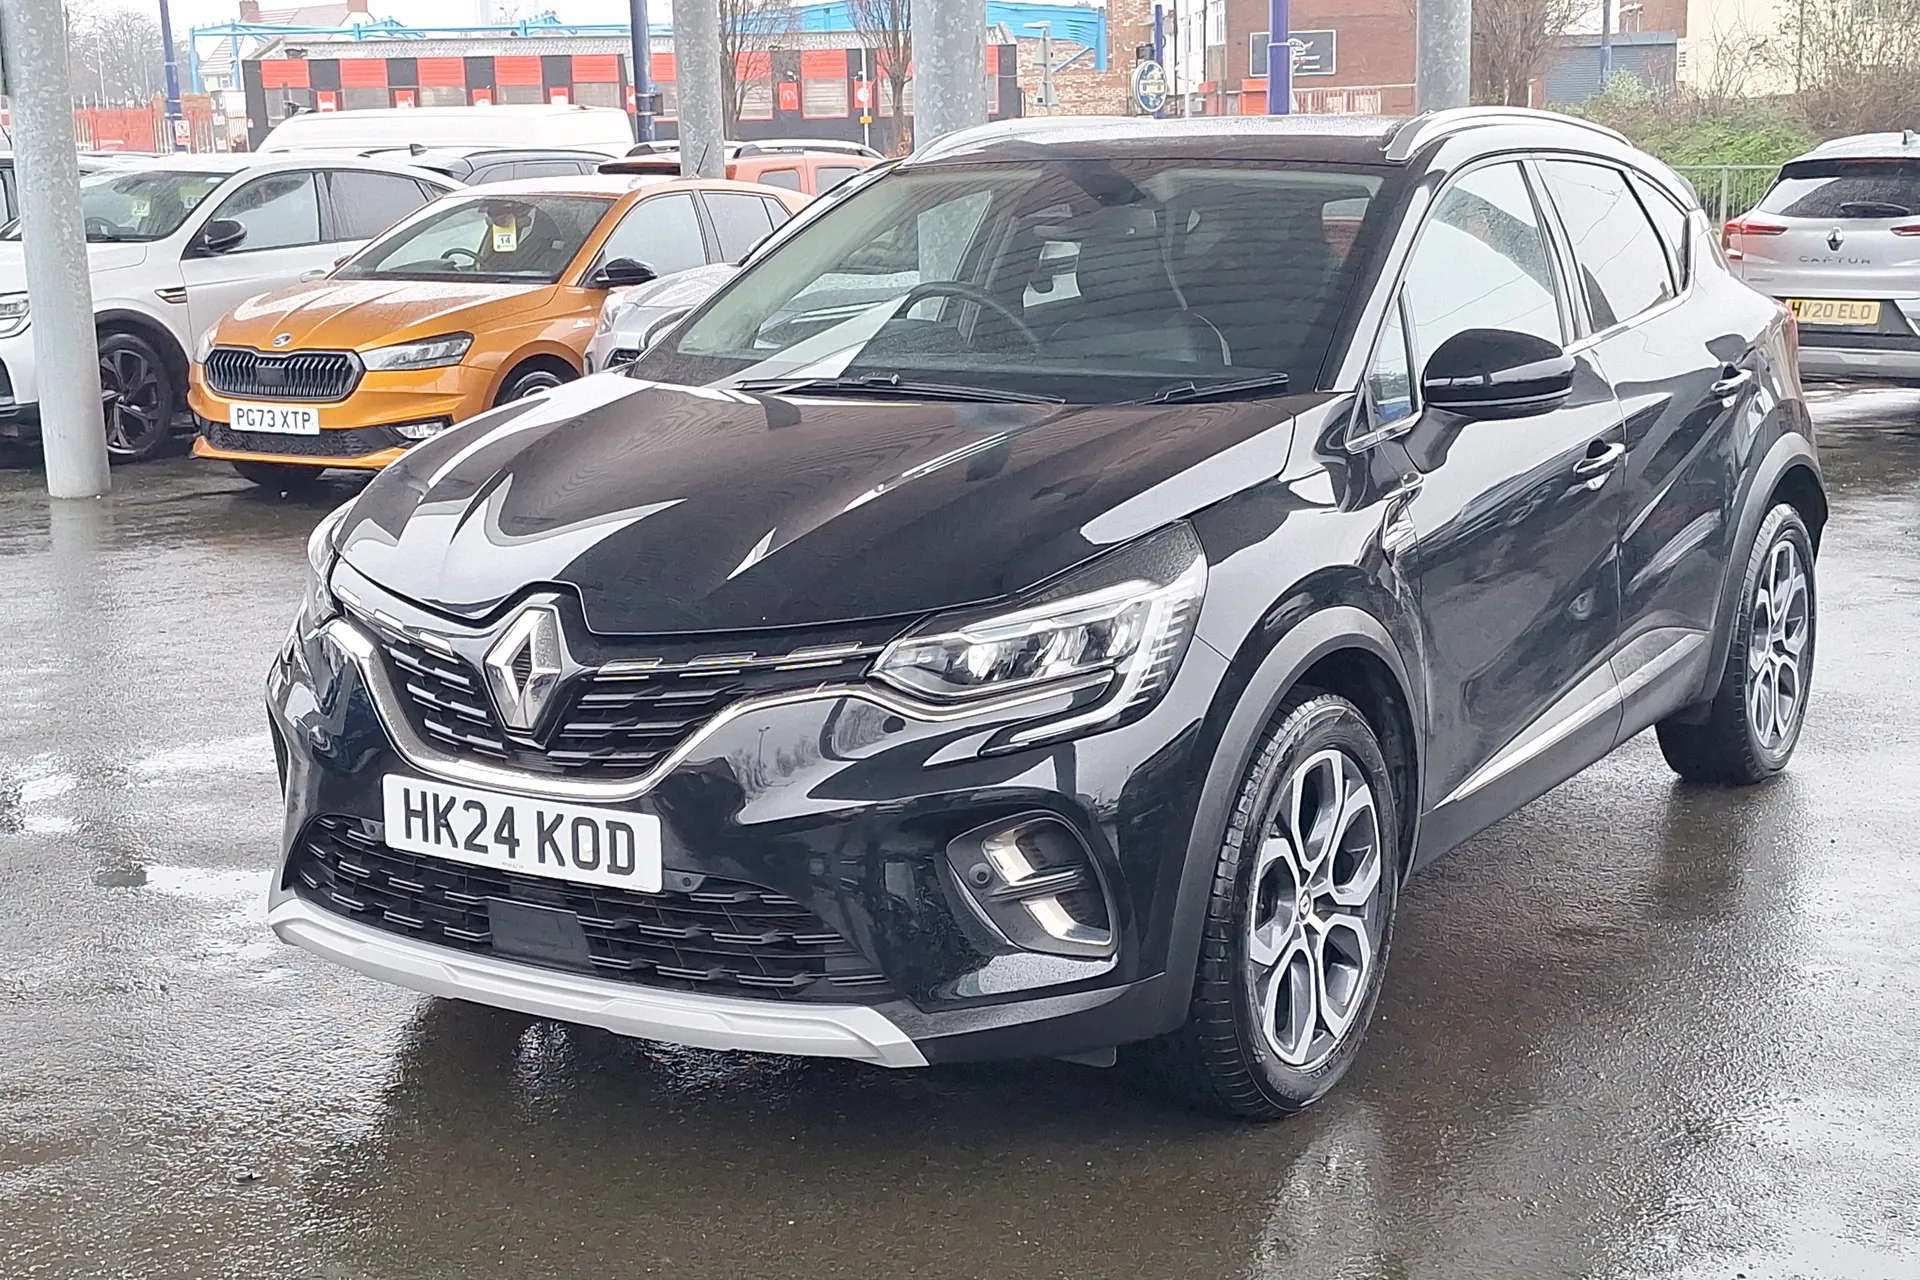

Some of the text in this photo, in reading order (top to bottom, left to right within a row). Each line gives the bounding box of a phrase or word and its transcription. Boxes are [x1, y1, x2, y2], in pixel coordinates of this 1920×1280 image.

[1791, 301, 1872, 320] HV20 ELO
[236, 407, 311, 430] PG73 XTP
[403, 787, 635, 876] HK24 KOD
